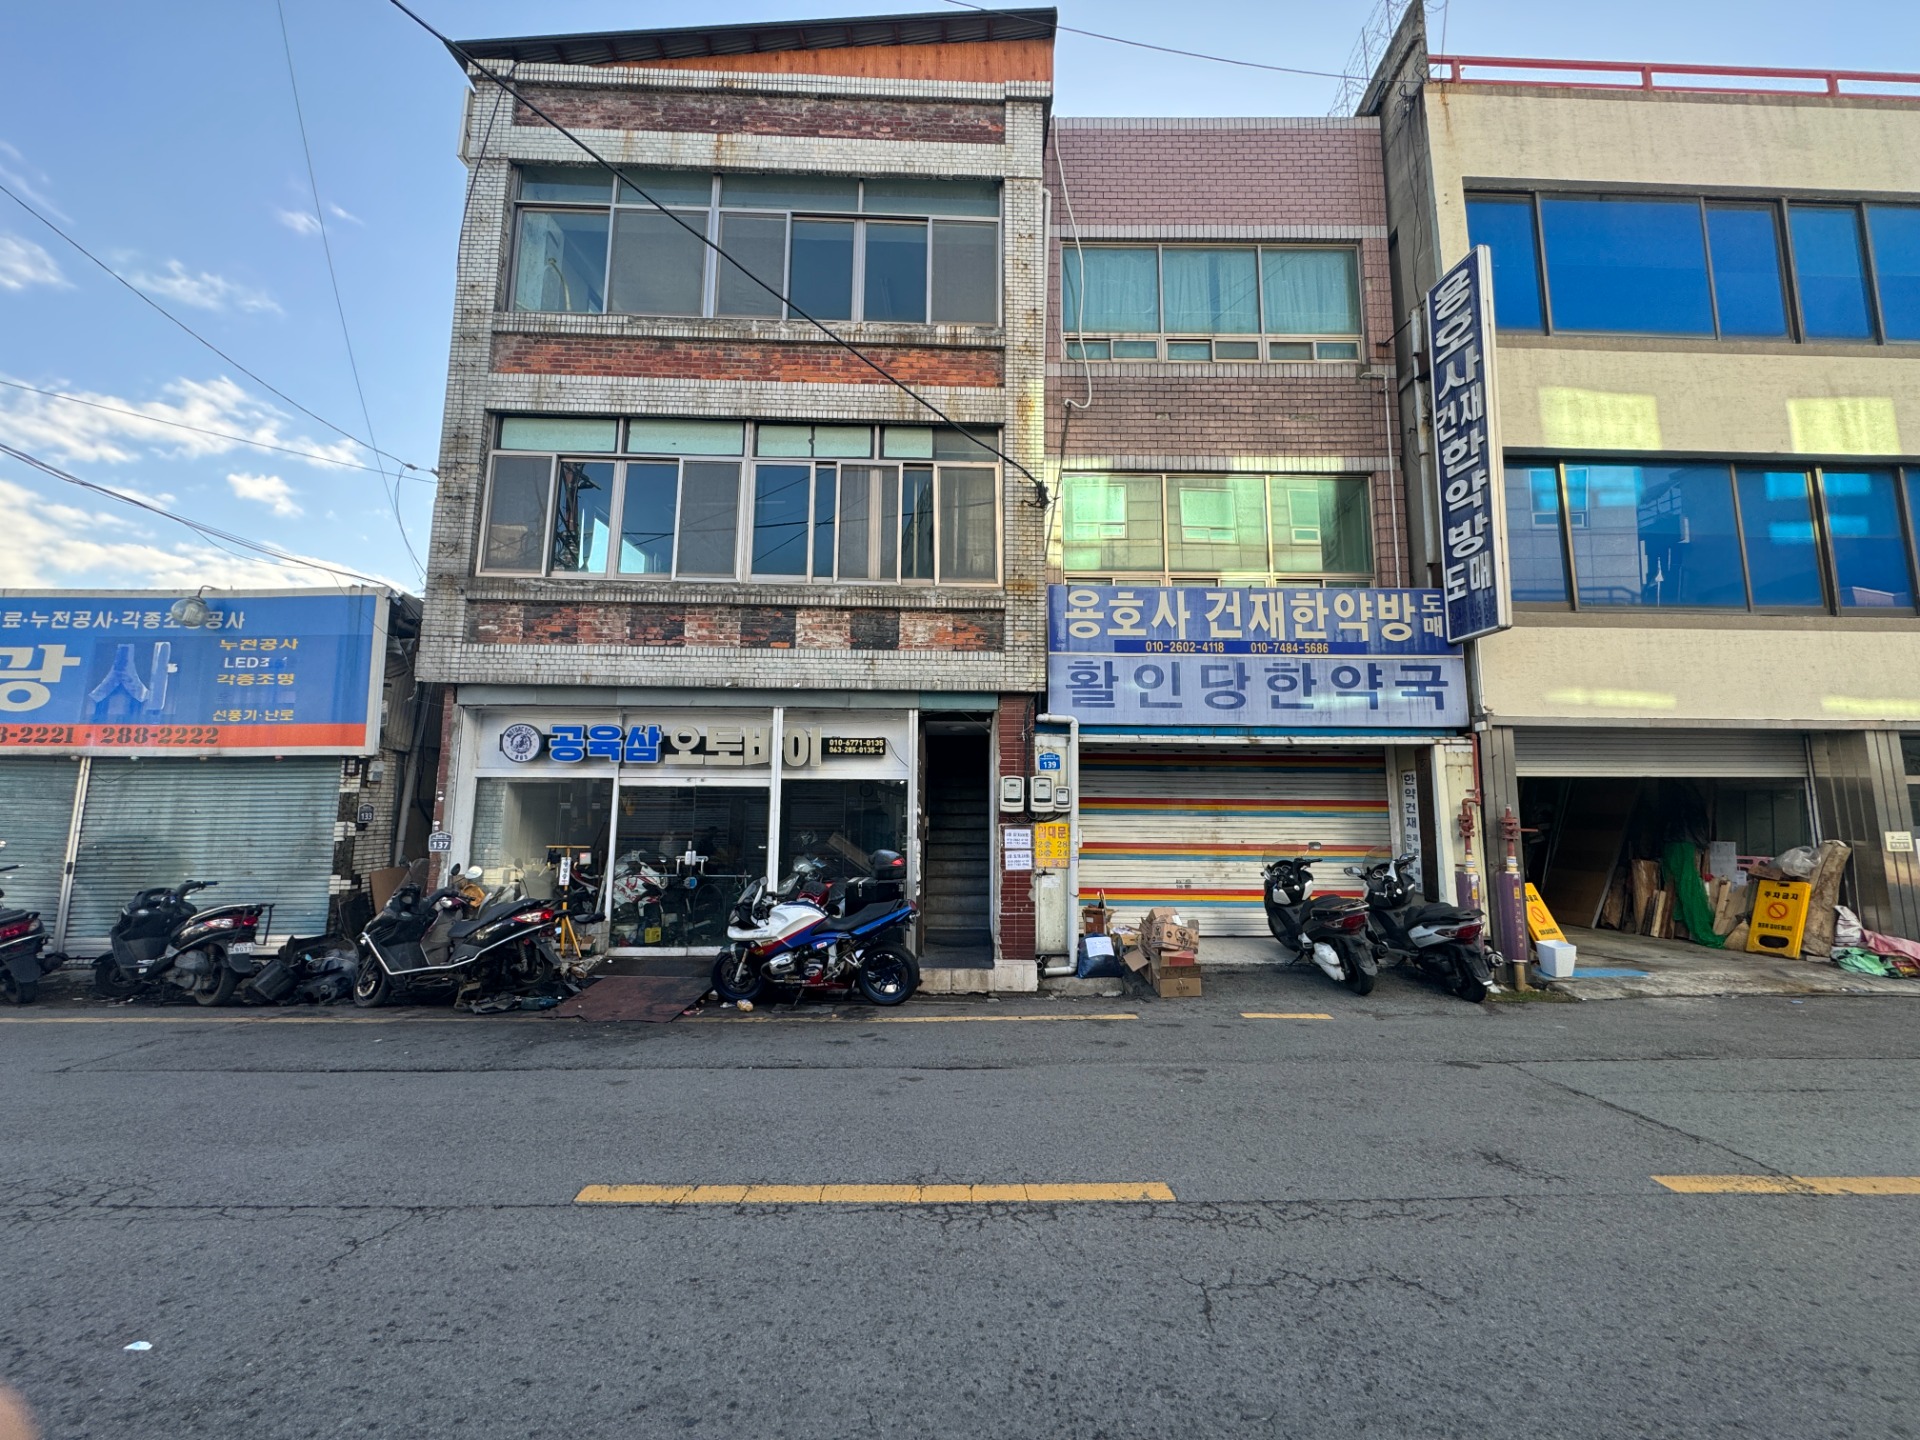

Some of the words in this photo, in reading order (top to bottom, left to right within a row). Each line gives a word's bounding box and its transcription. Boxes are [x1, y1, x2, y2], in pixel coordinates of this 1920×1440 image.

[1065, 589, 1190, 640] 용호사
[1205, 590, 1416, 642] 건재한약방
[1421, 594, 1444, 638] 도매
[219, 638, 299, 651] 누전공사
[1145, 641, 1225, 653] 010-2602-4118
[1250, 642, 1330, 654] 010-7484-5686
[216, 673, 295, 686] 각종조명
[1065, 660, 1449, 711] 활인당한약국
[212, 709, 295, 722] 선풍기·난로
[100, 726, 219, 745] 288-2222
[1043, 761, 1057, 769] 139
[1404, 773, 1417, 829] 한약건재
[360, 812, 372, 820] 133
[1037, 825, 1069, 839] 임대문
[432, 841, 449, 849] 137
[1764, 890, 1799, 900] 주차금지
